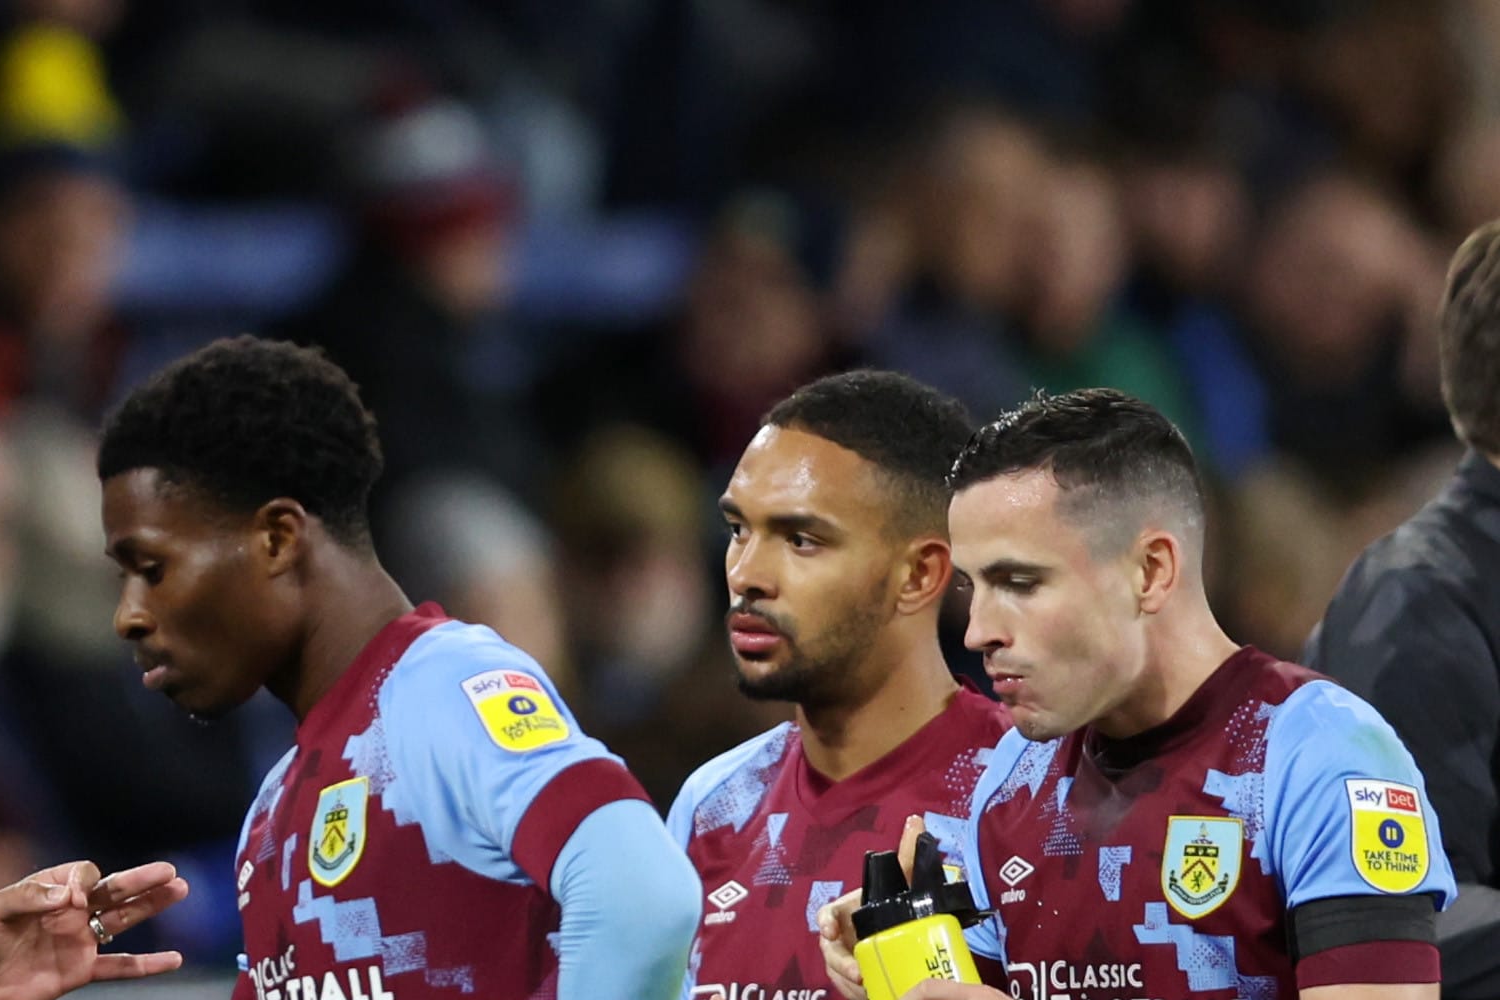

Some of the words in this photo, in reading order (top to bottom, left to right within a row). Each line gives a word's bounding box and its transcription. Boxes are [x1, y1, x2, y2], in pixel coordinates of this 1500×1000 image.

[1355, 787, 1383, 806] sky
[1388, 789, 1415, 808] bet
[1363, 850, 1392, 861] TAKE
[1394, 851, 1419, 863] TIME
[1367, 860, 1382, 870] TO
[1385, 861, 1419, 873] THINK
[1050, 960, 1143, 990] CLASSIC
